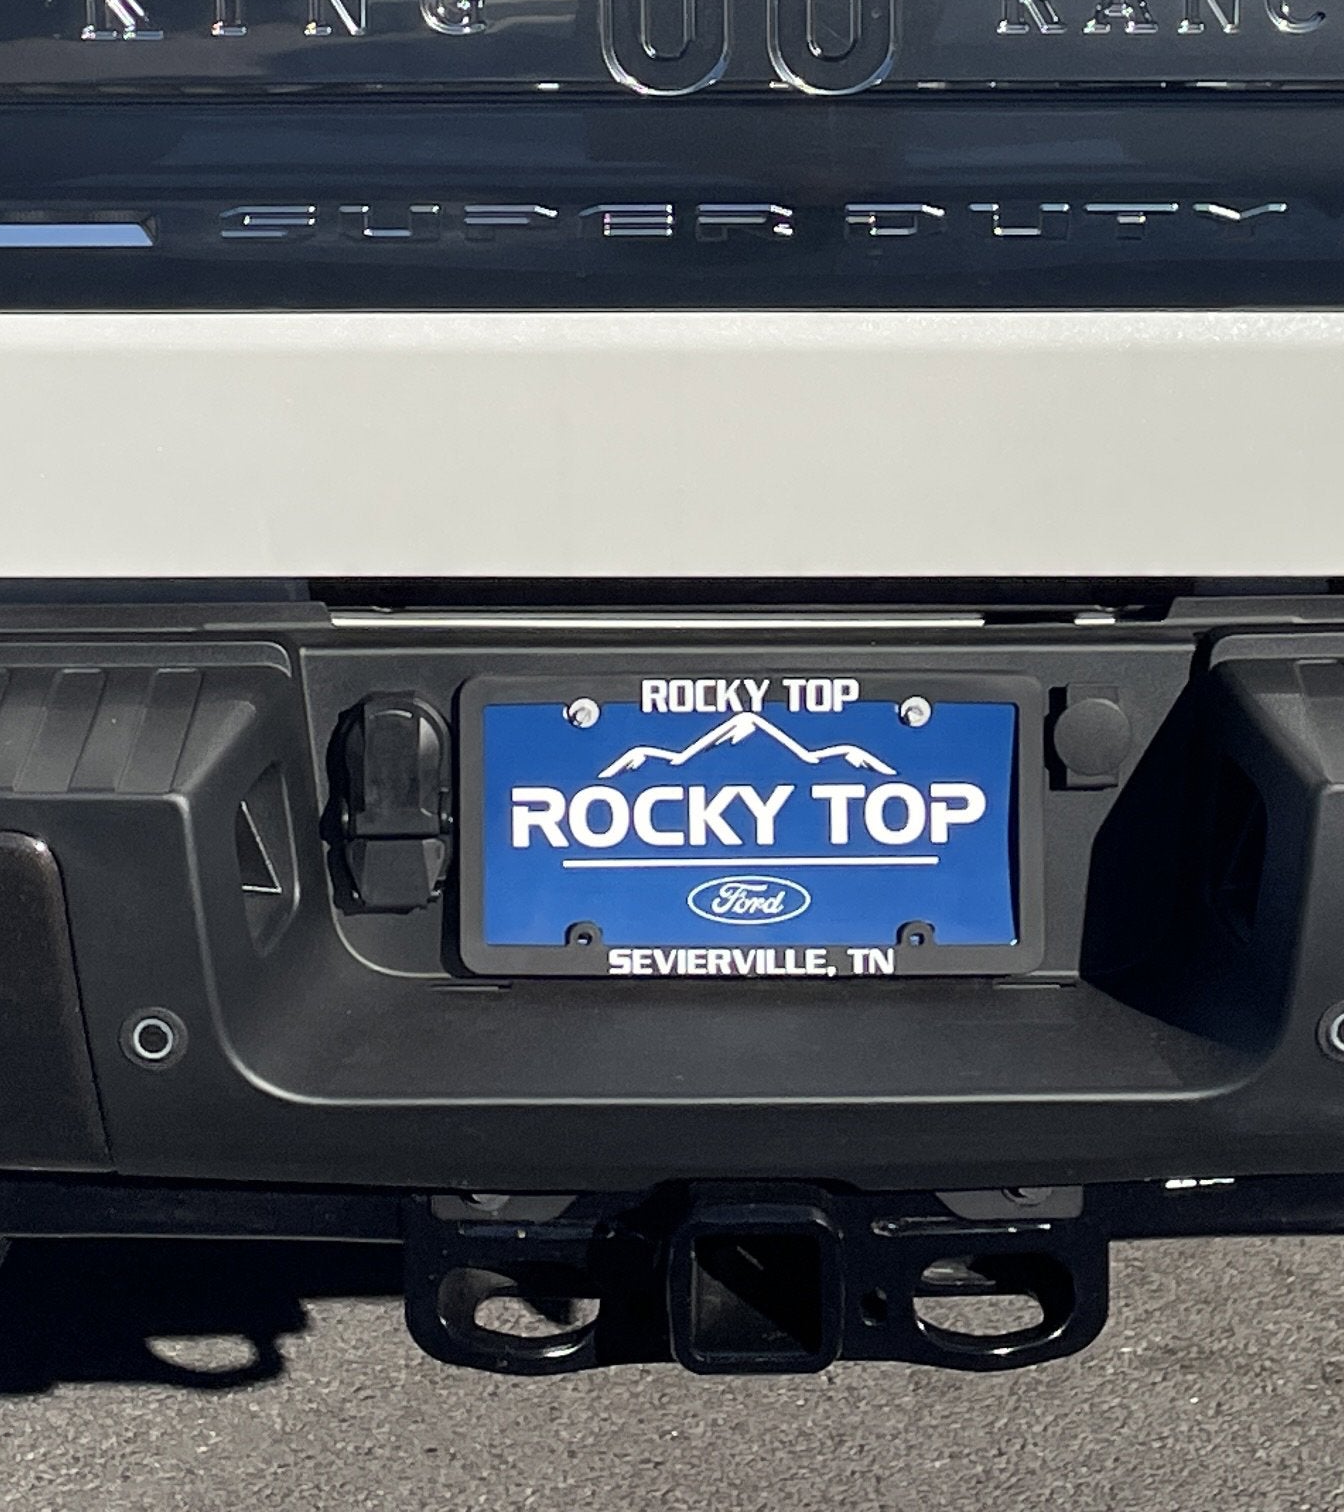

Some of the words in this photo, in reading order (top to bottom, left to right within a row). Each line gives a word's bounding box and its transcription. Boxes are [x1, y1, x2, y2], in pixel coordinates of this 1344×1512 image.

[218, 202, 794, 243] SUPER
[844, 201, 1288, 241] DUTY
[641, 678, 770, 713] ROCKY
[782, 678, 860, 713] TOP
[510, 784, 795, 849] ROCKY
[811, 782, 988, 845] TOP
[711, 882, 785, 915] Ford
[608, 948, 838, 977] SEVIERVILLE,
[847, 948, 895, 975] TN
